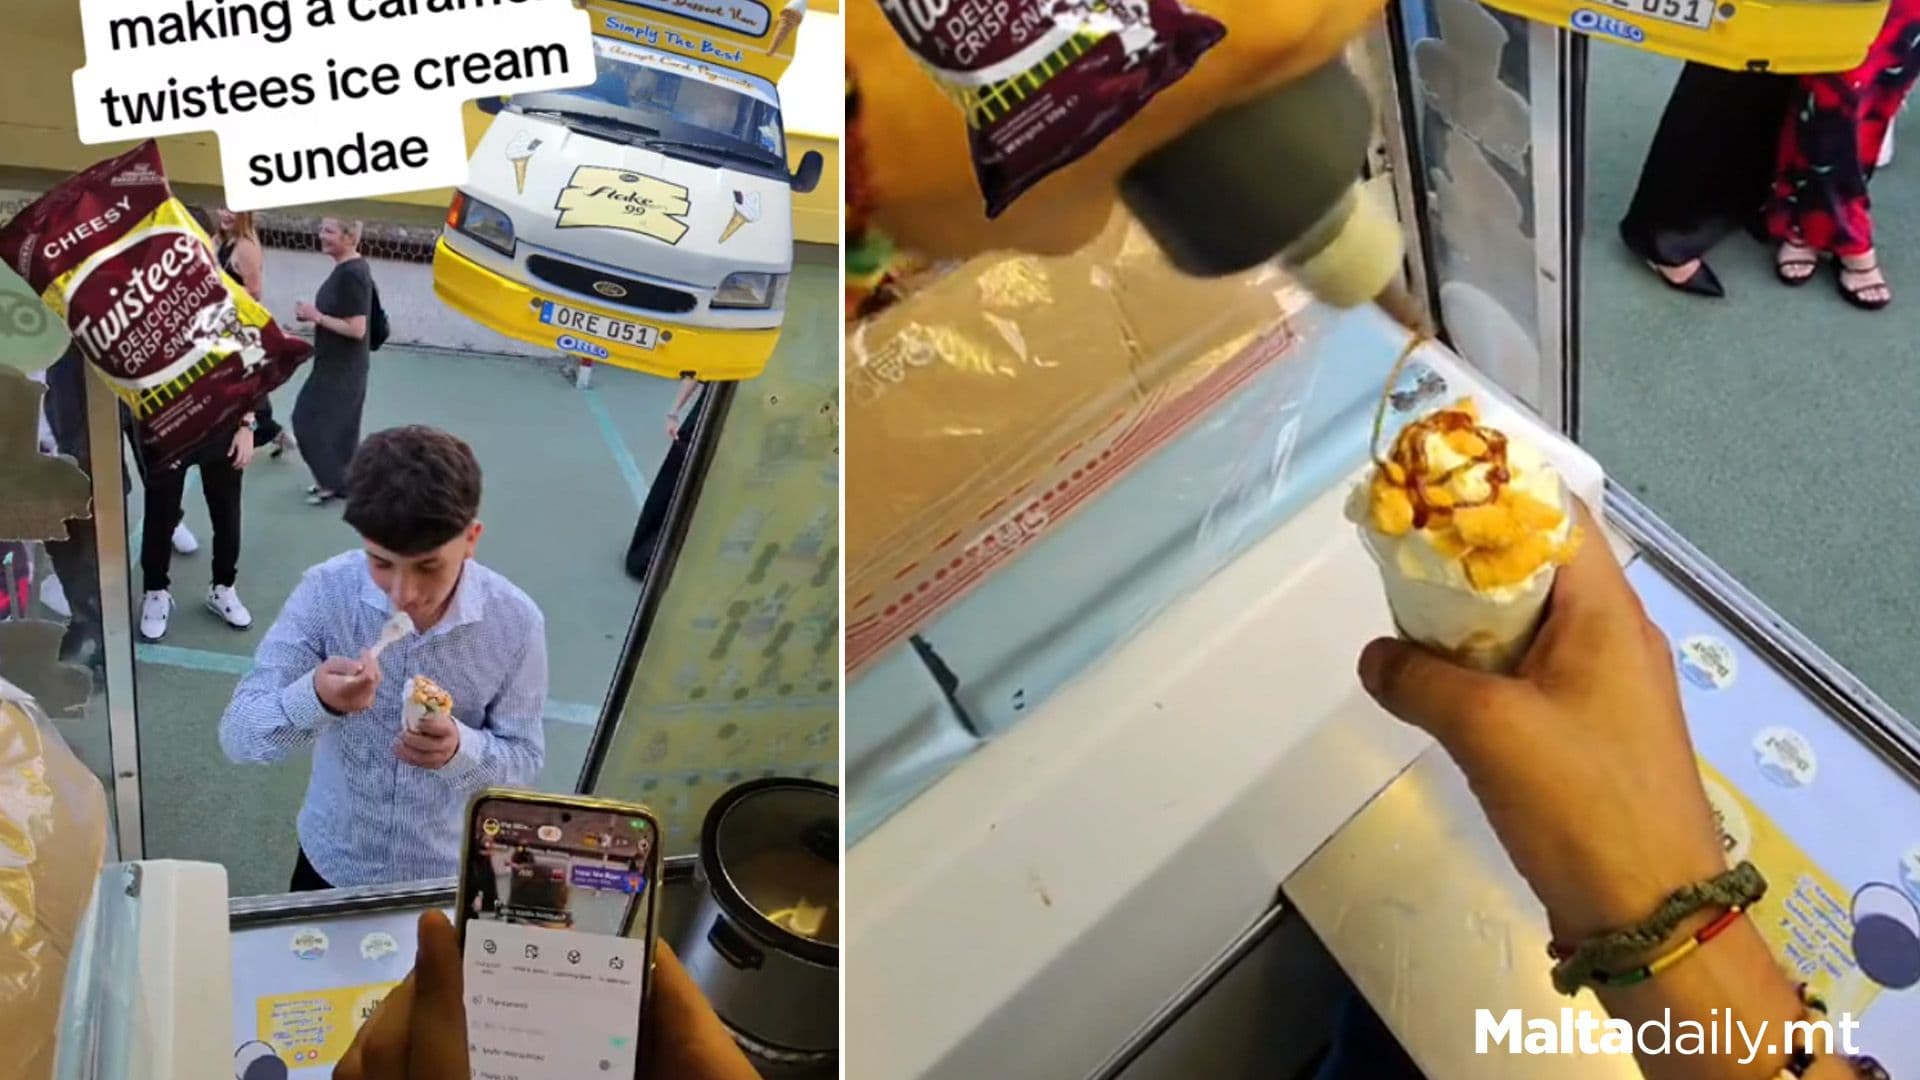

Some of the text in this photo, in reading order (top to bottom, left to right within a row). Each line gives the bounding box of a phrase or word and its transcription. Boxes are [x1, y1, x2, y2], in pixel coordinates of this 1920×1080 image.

[606, 16, 742, 62] Simply The Best
[954, 3, 1009, 65] CRISP
[1571, 8, 1645, 43] OREO
[43, 195, 131, 259] CHEESY
[624, 204, 646, 216] 99
[74, 234, 195, 360] Twistees
[118, 281, 190, 358] DELICIOUS
[557, 307, 648, 346] ORE 051
[557, 334, 608, 359] OREO
[124, 330, 164, 376] CRISP
